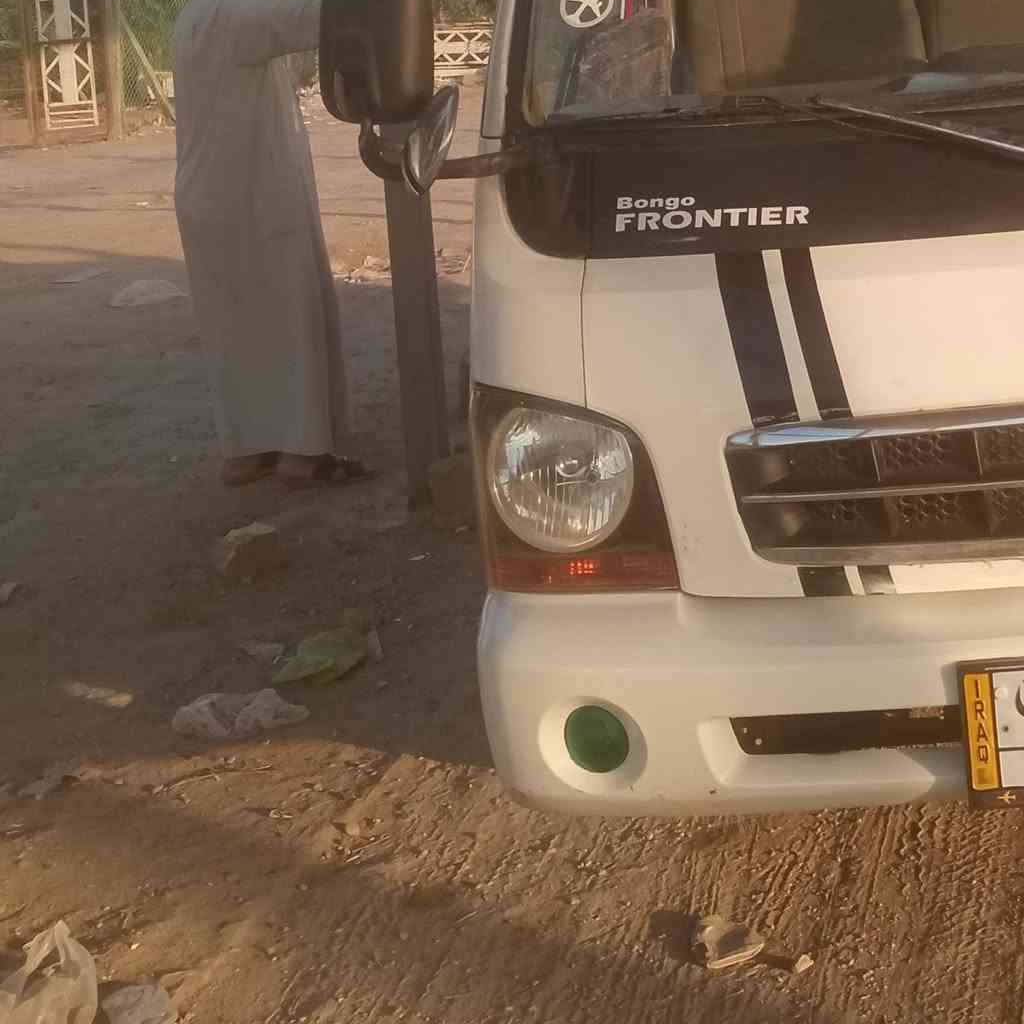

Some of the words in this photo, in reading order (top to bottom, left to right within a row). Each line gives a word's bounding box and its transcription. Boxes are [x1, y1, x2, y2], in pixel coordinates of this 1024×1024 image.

[616, 196, 696, 211] Bongo
[615, 205, 811, 233] FRONTIER
[970, 679, 990, 764] IRAQ
